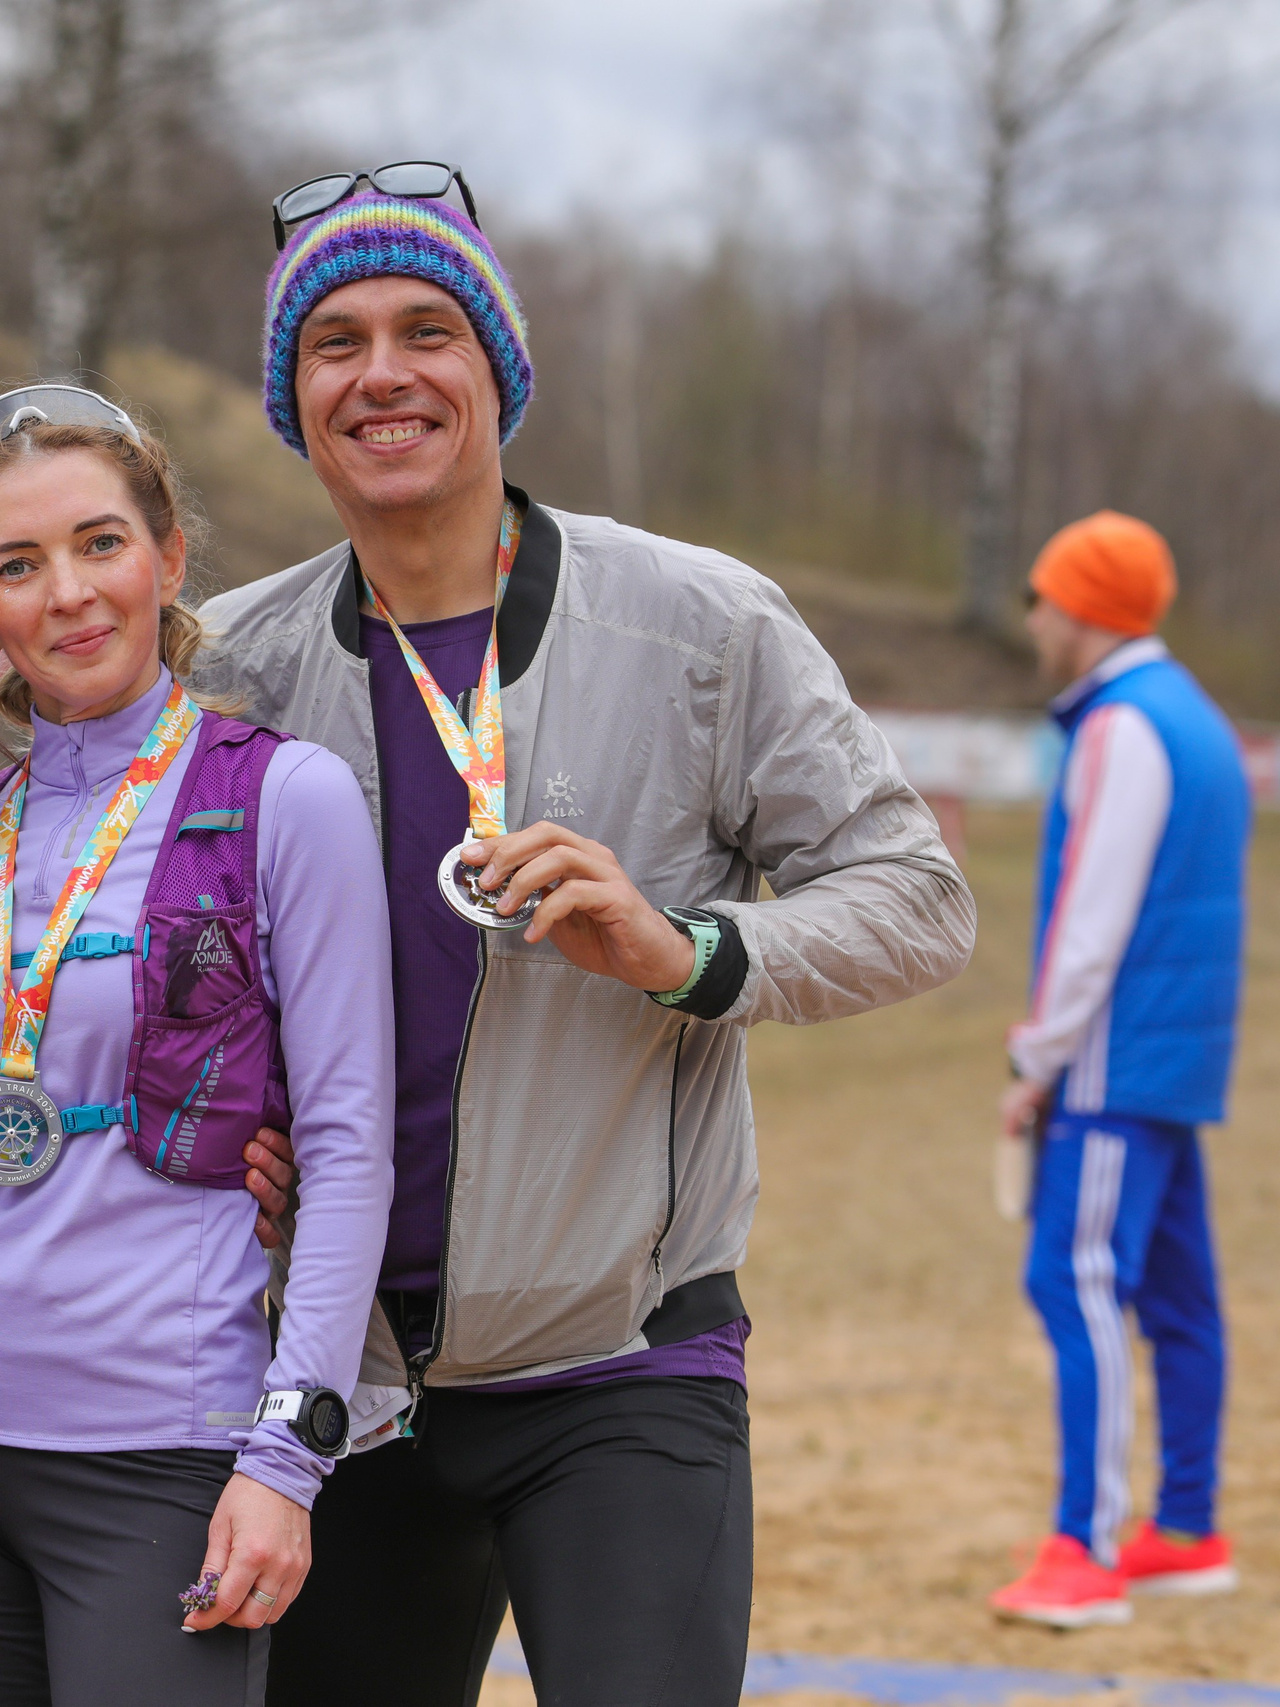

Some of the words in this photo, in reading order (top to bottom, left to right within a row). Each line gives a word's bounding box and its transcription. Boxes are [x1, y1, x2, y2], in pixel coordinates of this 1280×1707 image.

[483, 727, 494, 750] ЛЕС
[147, 742, 167, 764] ЛЕС
[0, 856, 9, 879] ЛЕС
[46, 857, 95, 948] #ХИМКИНСКИЙ
[36, 946, 51, 972] ЛЕС
[6, 1083, 34, 1098] TRAIL
[36, 1095, 55, 1118] 2024
[7, 1171, 31, 1182] ХИМКИ
[32, 1146, 56, 1176] 14.04.2024
